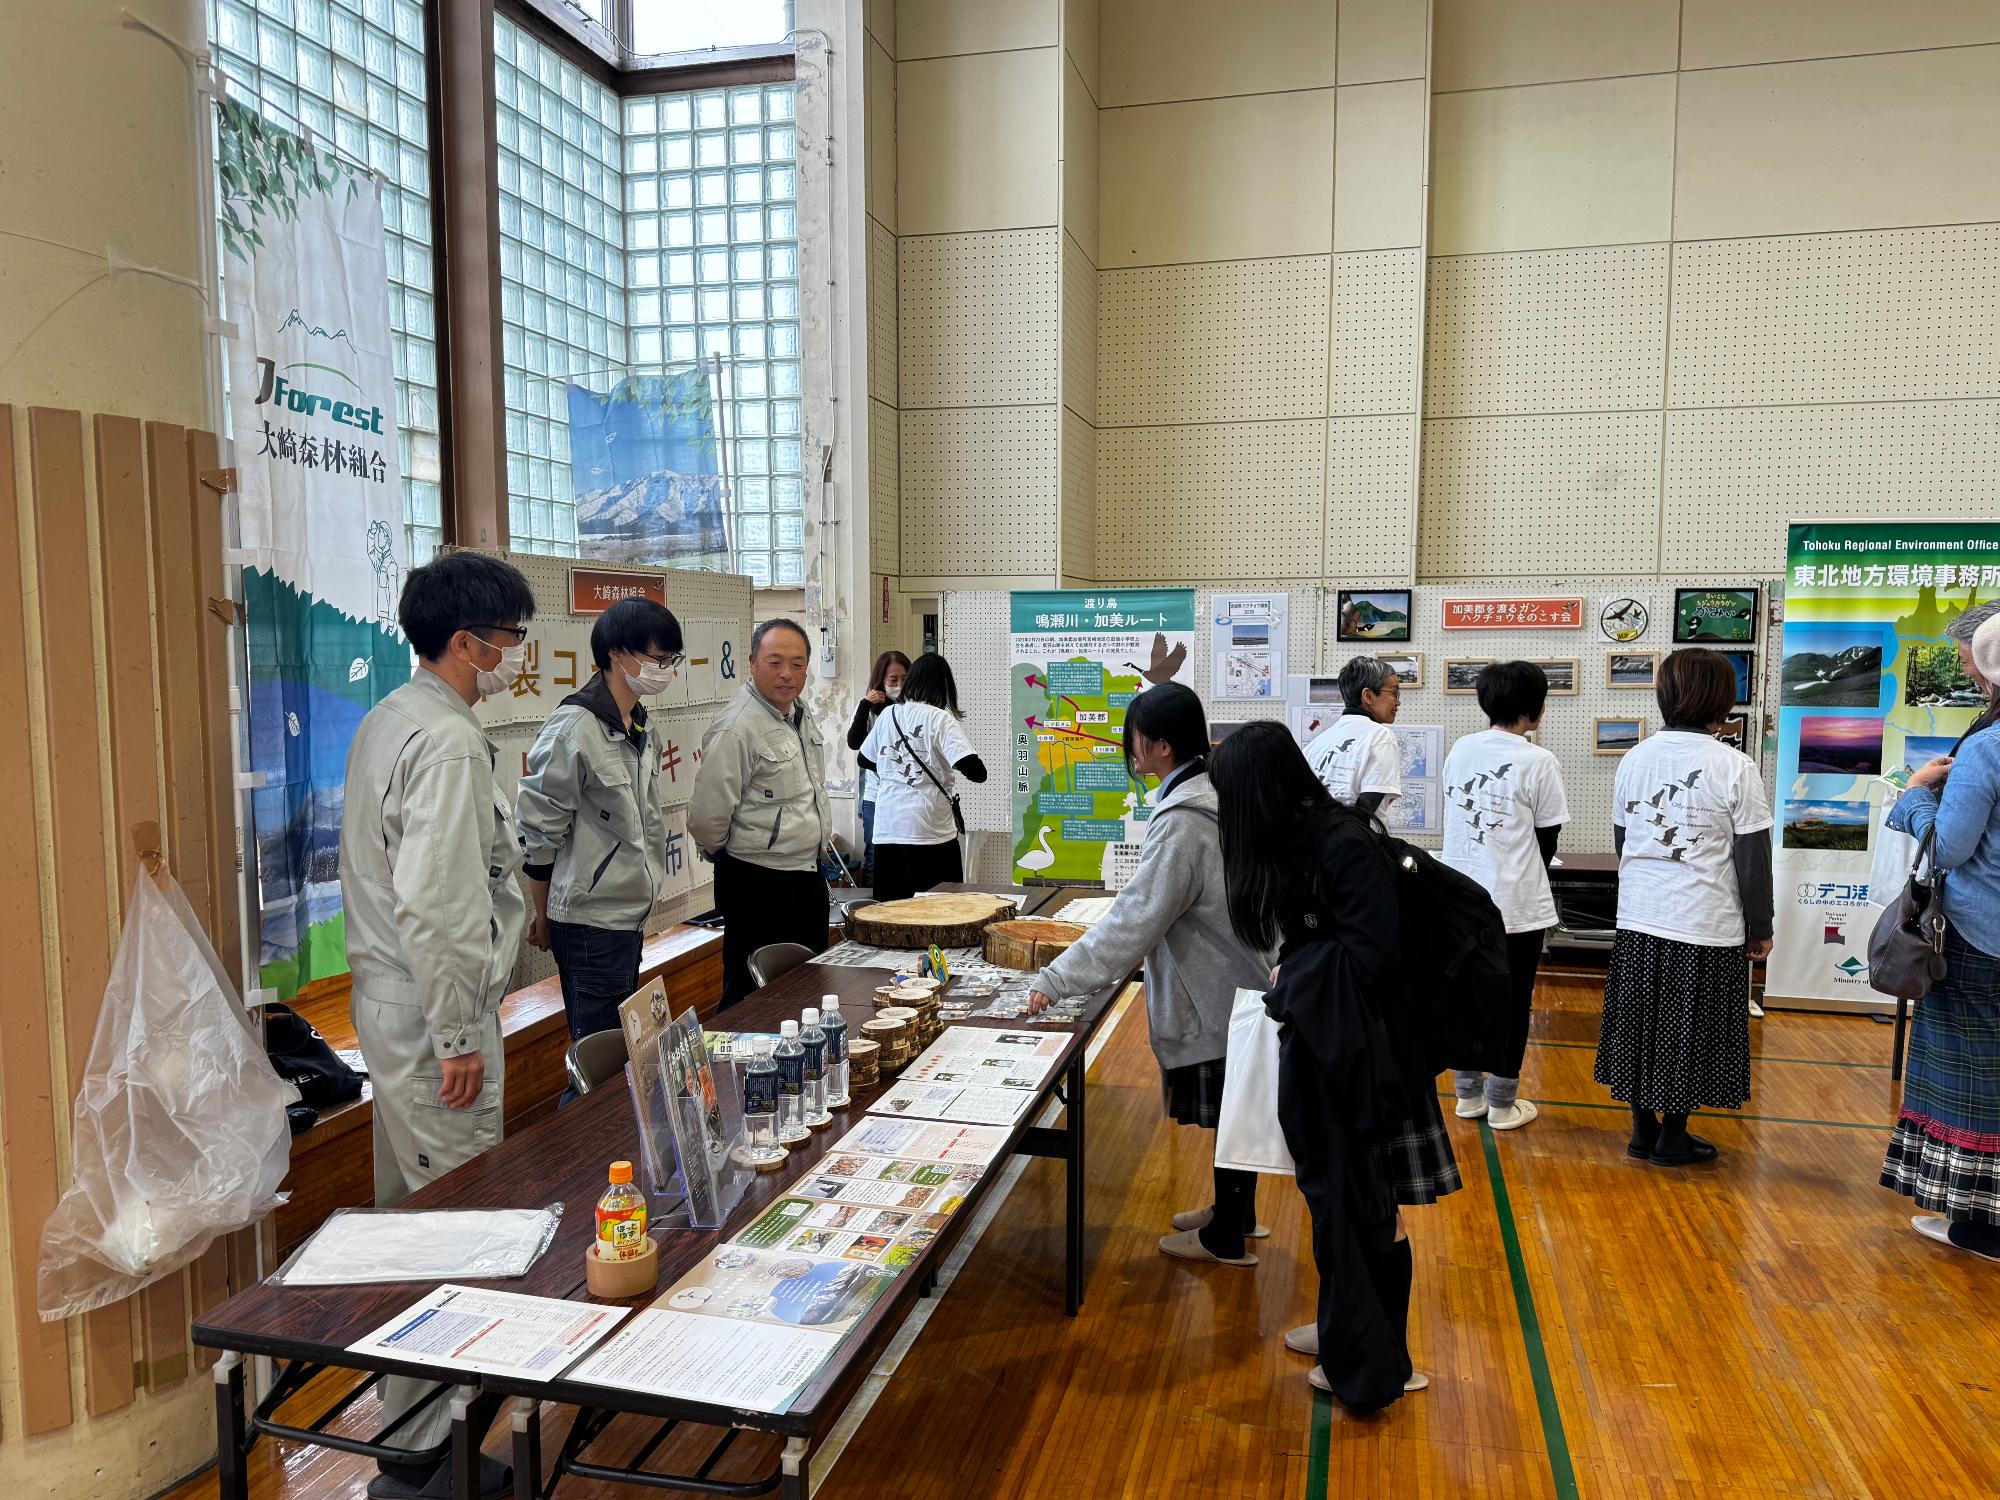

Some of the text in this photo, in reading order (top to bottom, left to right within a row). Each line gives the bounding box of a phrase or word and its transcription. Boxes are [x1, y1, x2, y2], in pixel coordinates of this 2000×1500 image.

[255, 419, 387, 484] 大崎森林組合
[1802, 539, 1999, 552] Tohoku Regional Environment Office
[1793, 564, 2000, 588] 東北地方環境事務所
[593, 584, 646, 601] 大崎森林組合
[1084, 597, 1118, 609] 渡り鳥
[1035, 612, 1168, 628] 鳴瀬川・加美ルート
[1461, 611, 1572, 624] ハクチョウをのこす会
[1079, 713, 1106, 722] 加美郡
[1017, 734, 1028, 792] 奥羽山脈
[1817, 882, 1870, 900] デコ活
[1833, 977, 1862, 986] Ministry
[619, 1230, 636, 1240] ゆず
